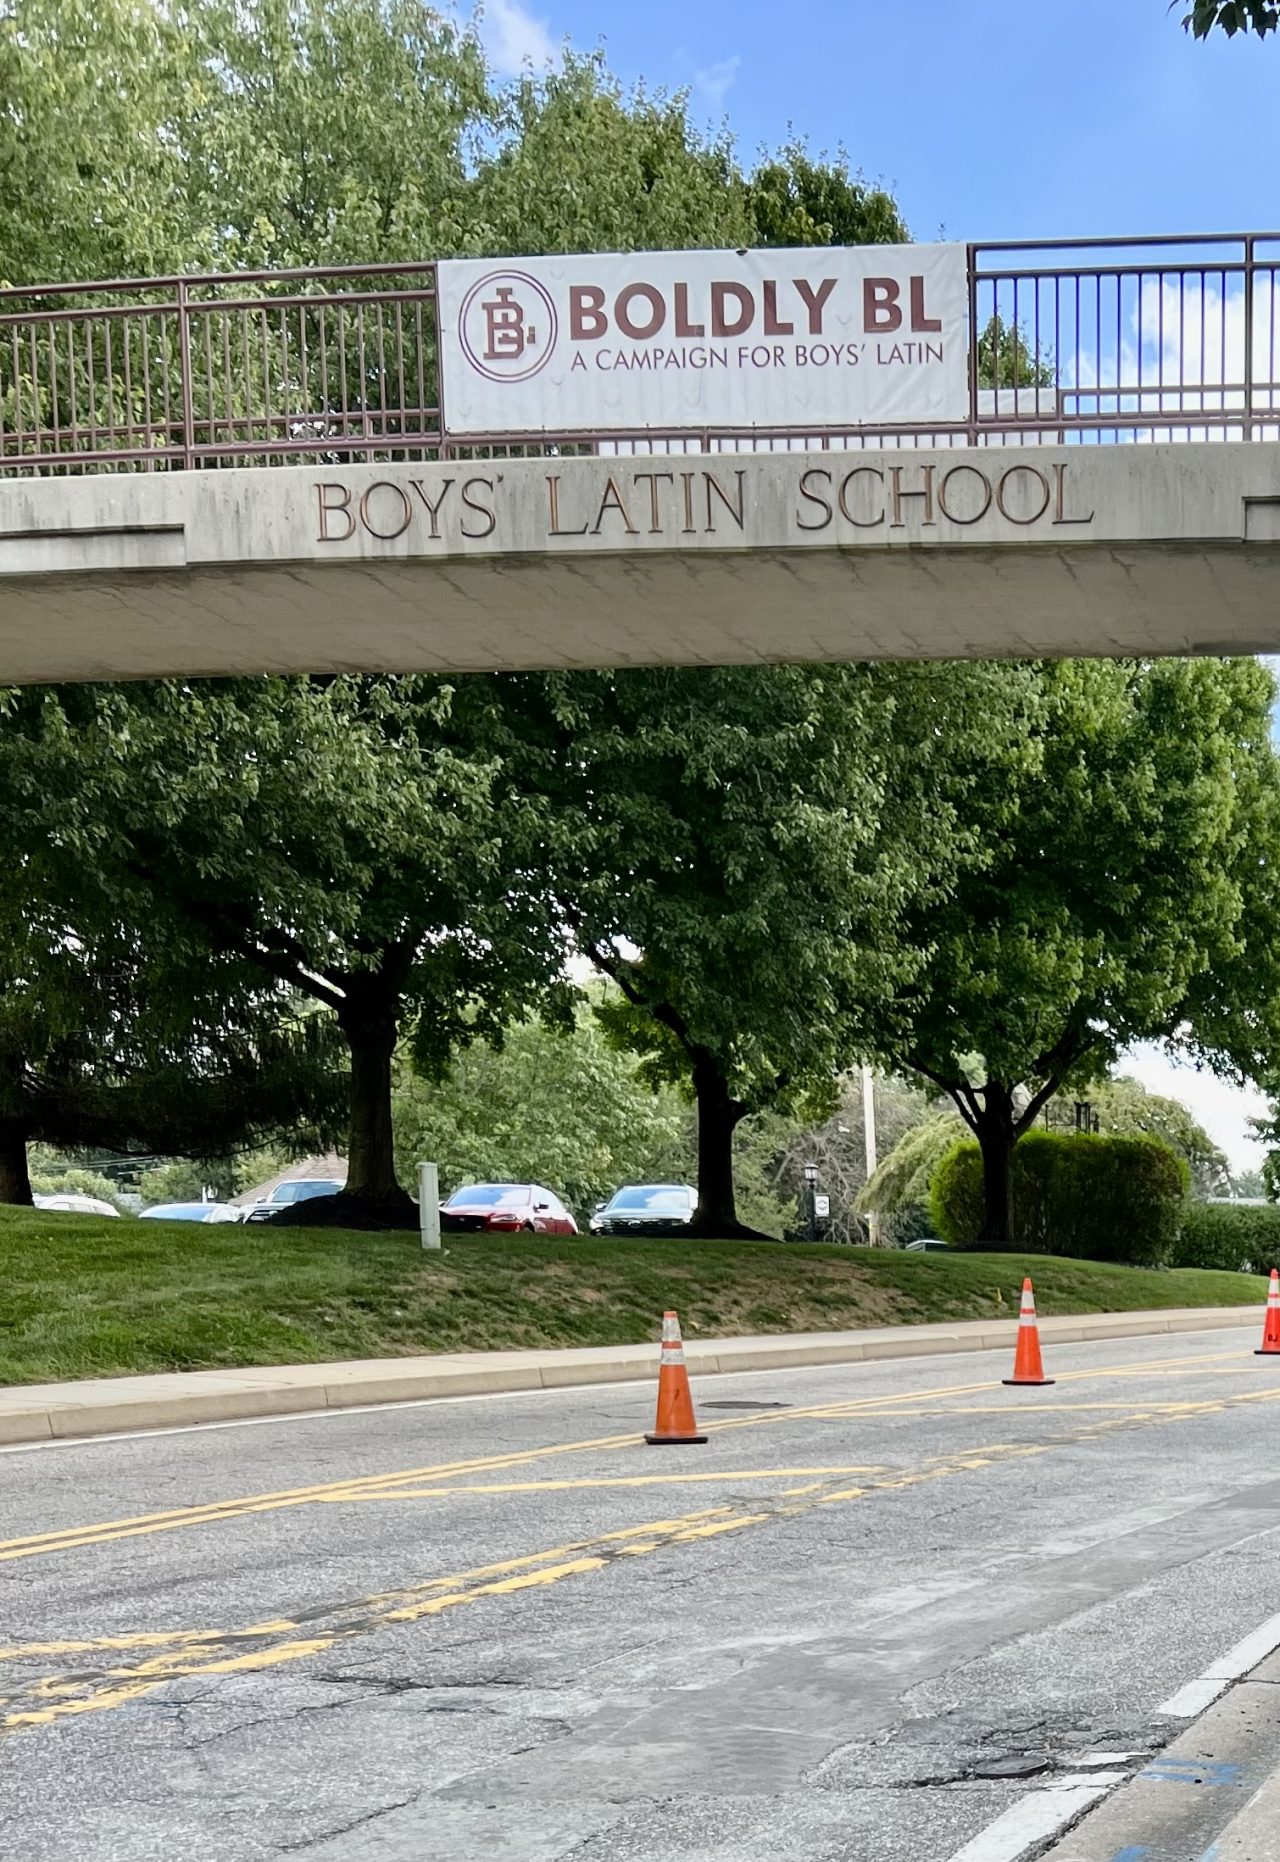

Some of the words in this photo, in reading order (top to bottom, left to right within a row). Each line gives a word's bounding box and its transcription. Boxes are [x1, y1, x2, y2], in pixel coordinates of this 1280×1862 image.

[569, 278, 838, 341] BOLDLY
[862, 275, 943, 334] BL
[570, 350, 587, 371] A
[595, 346, 728, 371] CAMPAIGN
[737, 345, 786, 368] FOR
[794, 342, 866, 367] BOYS'
[876, 341, 944, 365] LATIN
[313, 475, 504, 543] BOYS'
[546, 469, 748, 537] LATIN
[797, 462, 1096, 530] SCHOOL
